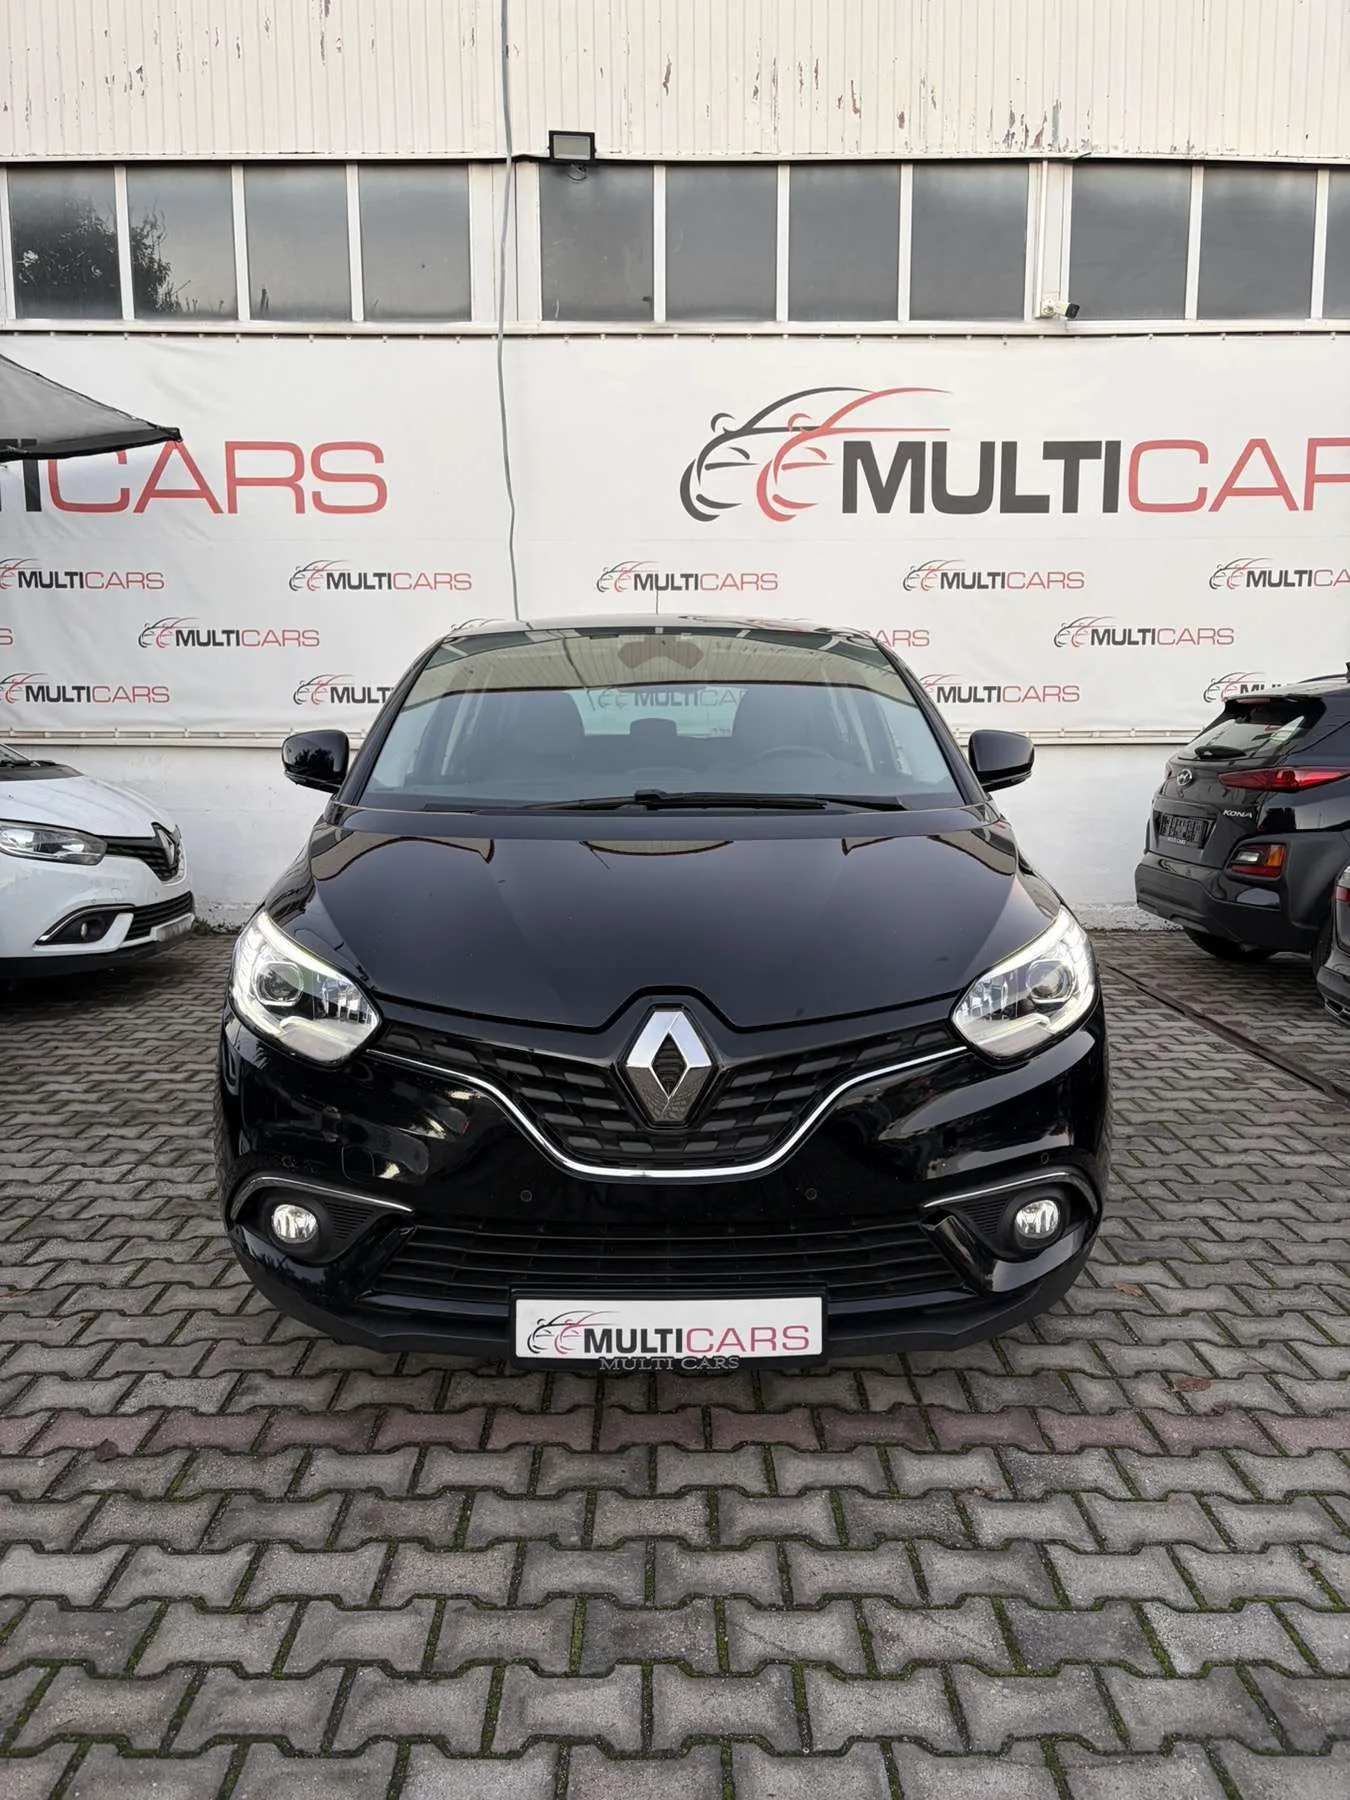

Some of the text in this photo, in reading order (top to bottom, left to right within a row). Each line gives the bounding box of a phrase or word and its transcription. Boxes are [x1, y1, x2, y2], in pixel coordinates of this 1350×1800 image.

[0, 439, 389, 514] ICARS
[18, 571, 164, 590] MULTICARS
[326, 572, 472, 591] MULTICARS
[633, 572, 778, 591] MULTICARS
[940, 571, 1085, 590] MULTICARS
[175, 629, 320, 647] MULTICARS
[862, 630, 930, 647] ARS
[1090, 628, 1235, 647] MULTICARS
[25, 685, 170, 704] MULTICARS
[330, 686, 394, 704] MULT
[936, 685, 1080, 704] MULTICARS
[1222, 809, 1253, 818] KONA
[583, 1325, 809, 1354] MULTICARS
[599, 1356, 740, 1370] MULTI CARS
